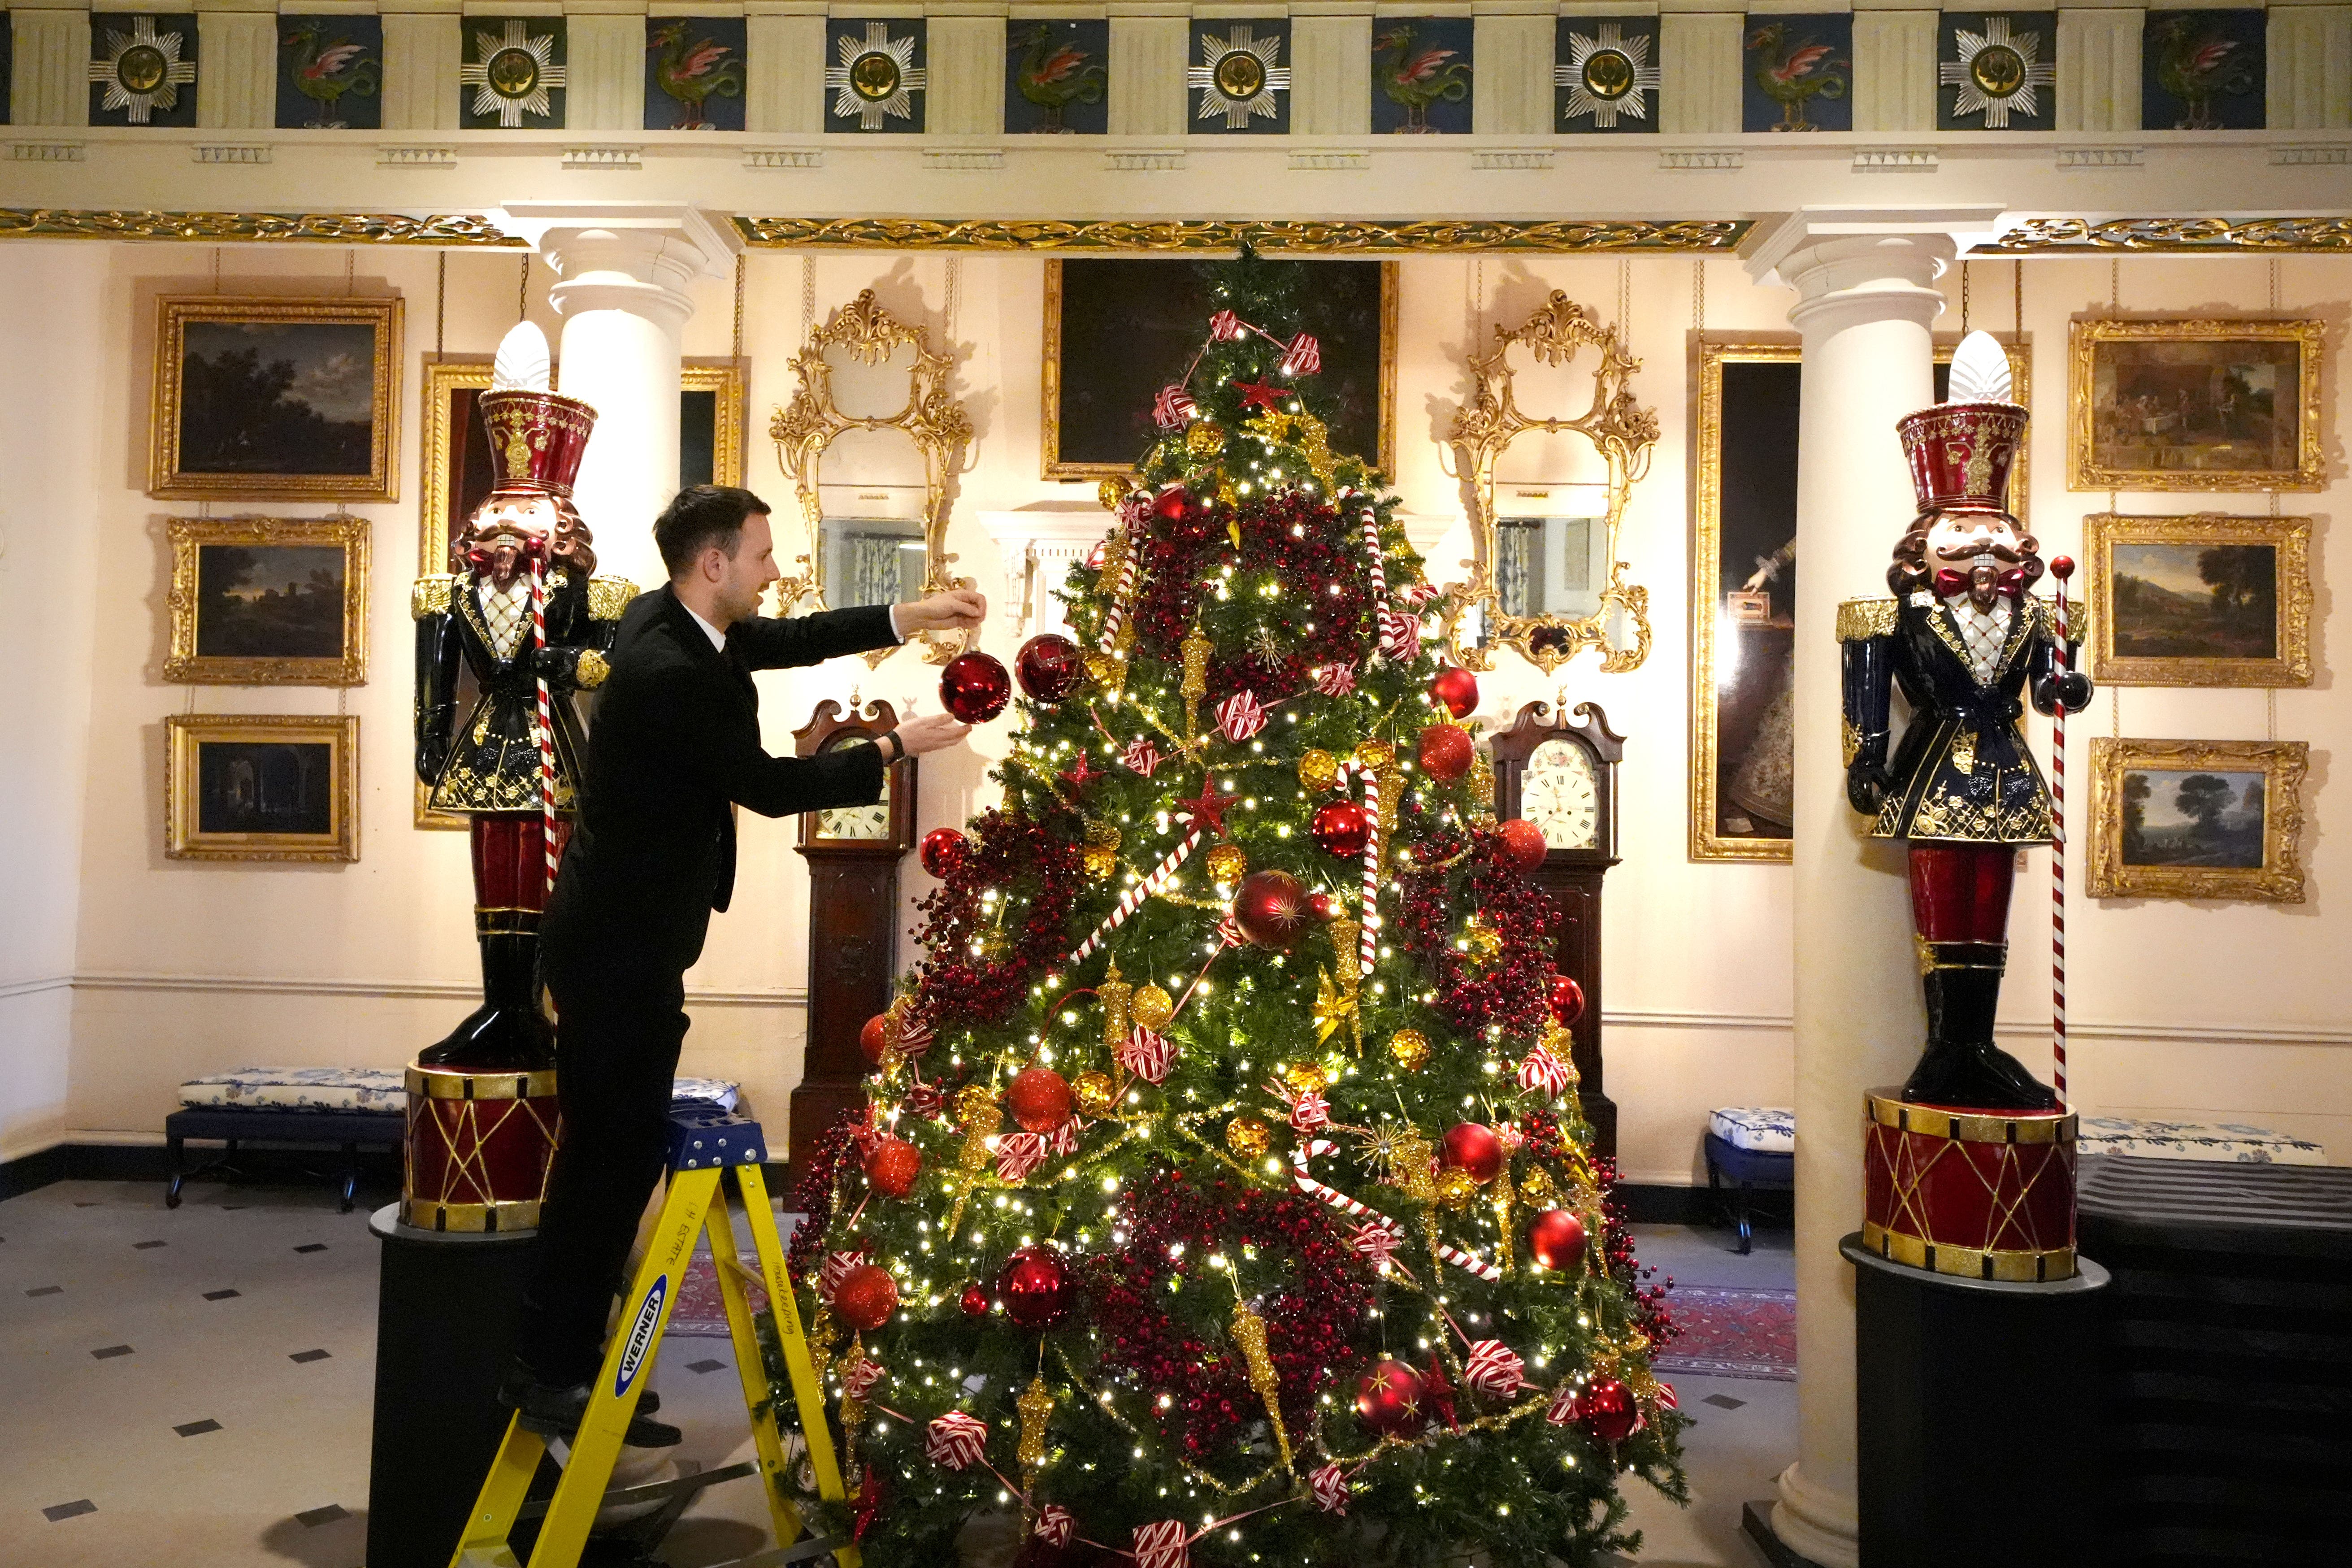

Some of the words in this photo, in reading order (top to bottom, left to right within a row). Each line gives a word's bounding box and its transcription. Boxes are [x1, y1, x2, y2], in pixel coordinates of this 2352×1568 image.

[666, 1224, 690, 1266] ESTATE
[772, 1262, 794, 1334] Housekeeping
[624, 1297, 659, 1373] WERNER
